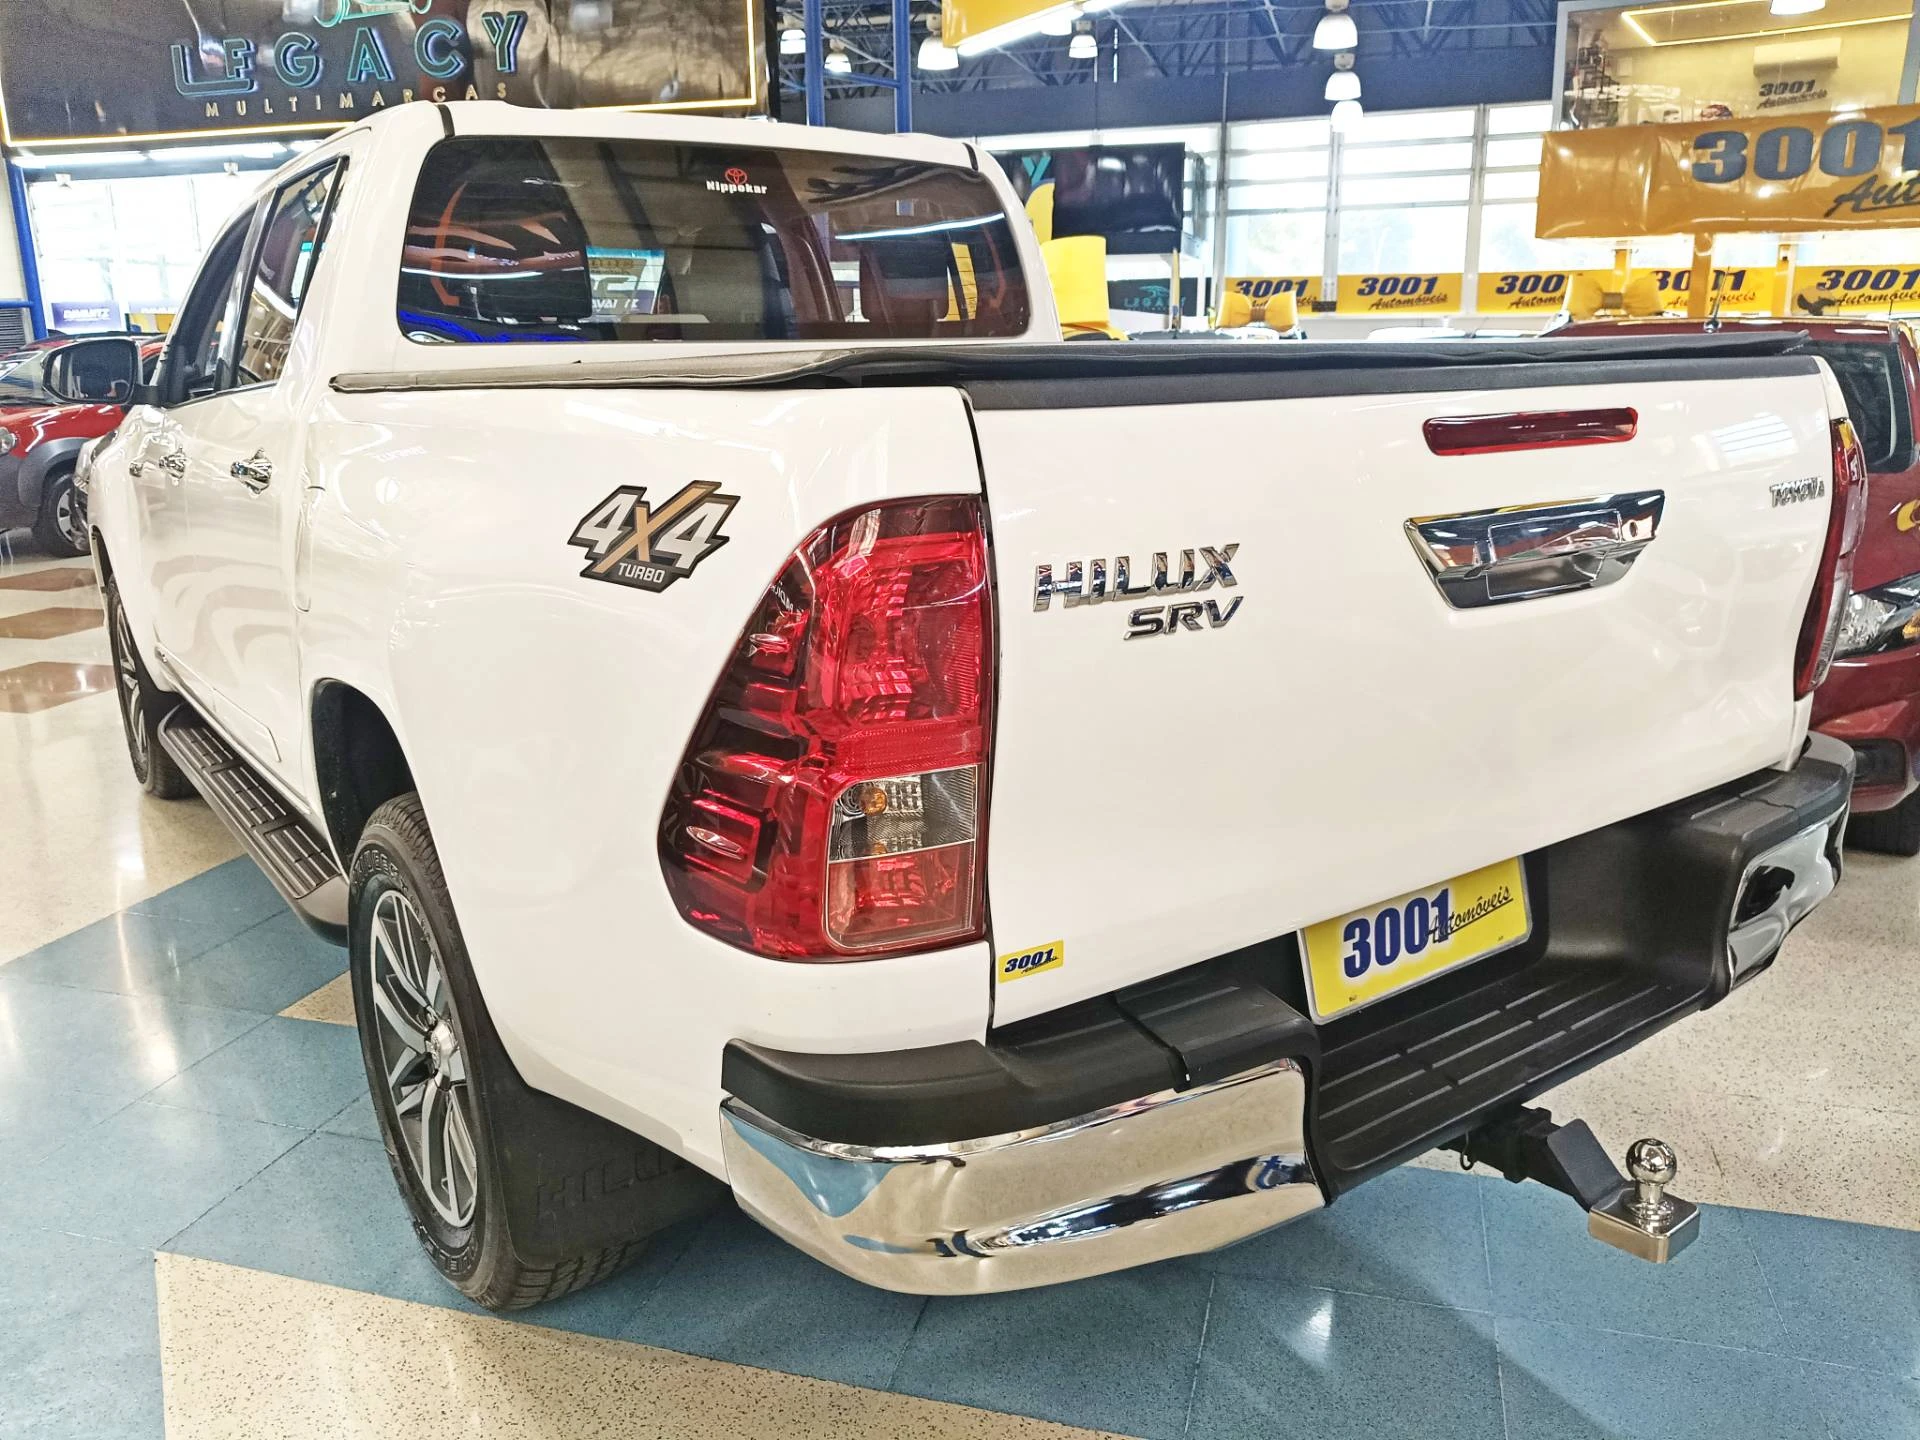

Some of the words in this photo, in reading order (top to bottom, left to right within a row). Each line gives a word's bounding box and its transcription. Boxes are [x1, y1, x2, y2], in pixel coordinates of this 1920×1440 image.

[171, 11, 528, 97] LEGACY
[205, 82, 508, 118] MULTIMARCAS
[1759, 79, 1816, 97] 3001
[1691, 116, 1920, 184] 3001
[706, 180, 768, 195] Nippokar
[1357, 276, 1439, 296] 3001
[1496, 274, 1566, 295] 300
[1816, 268, 1920, 291] 3001
[617, 562, 666, 584] TURBO
[1033, 543, 1240, 612] HILUX
[1124, 596, 1244, 640] SRV
[1342, 888, 1450, 978] 3001
[1004, 948, 1054, 973] 3001
